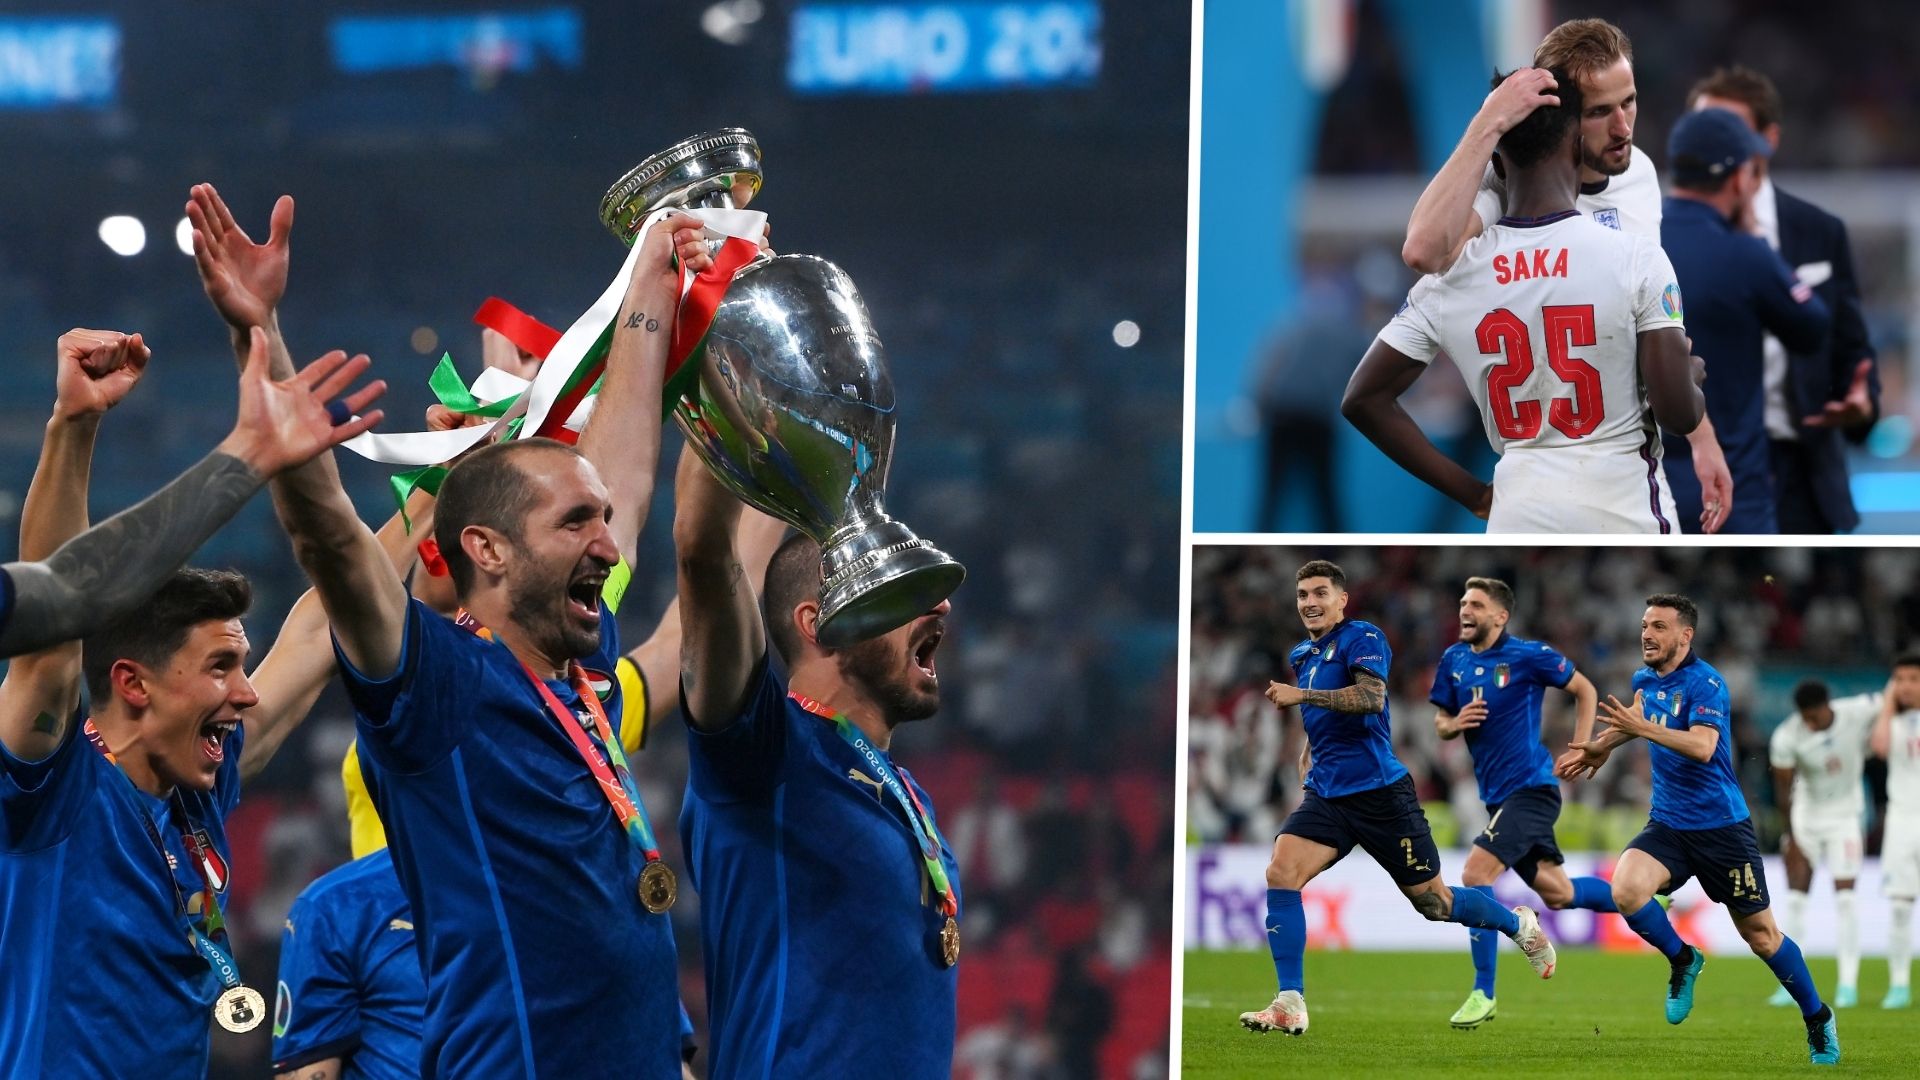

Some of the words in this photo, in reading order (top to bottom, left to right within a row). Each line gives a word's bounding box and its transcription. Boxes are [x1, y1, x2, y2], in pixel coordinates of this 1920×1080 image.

[1492, 248, 1569, 285] SAKA
[1475, 304, 1606, 440] 25
[854, 738, 880, 768] 2020
[1400, 837, 1418, 867] 2
[1729, 862, 1758, 897] 24
